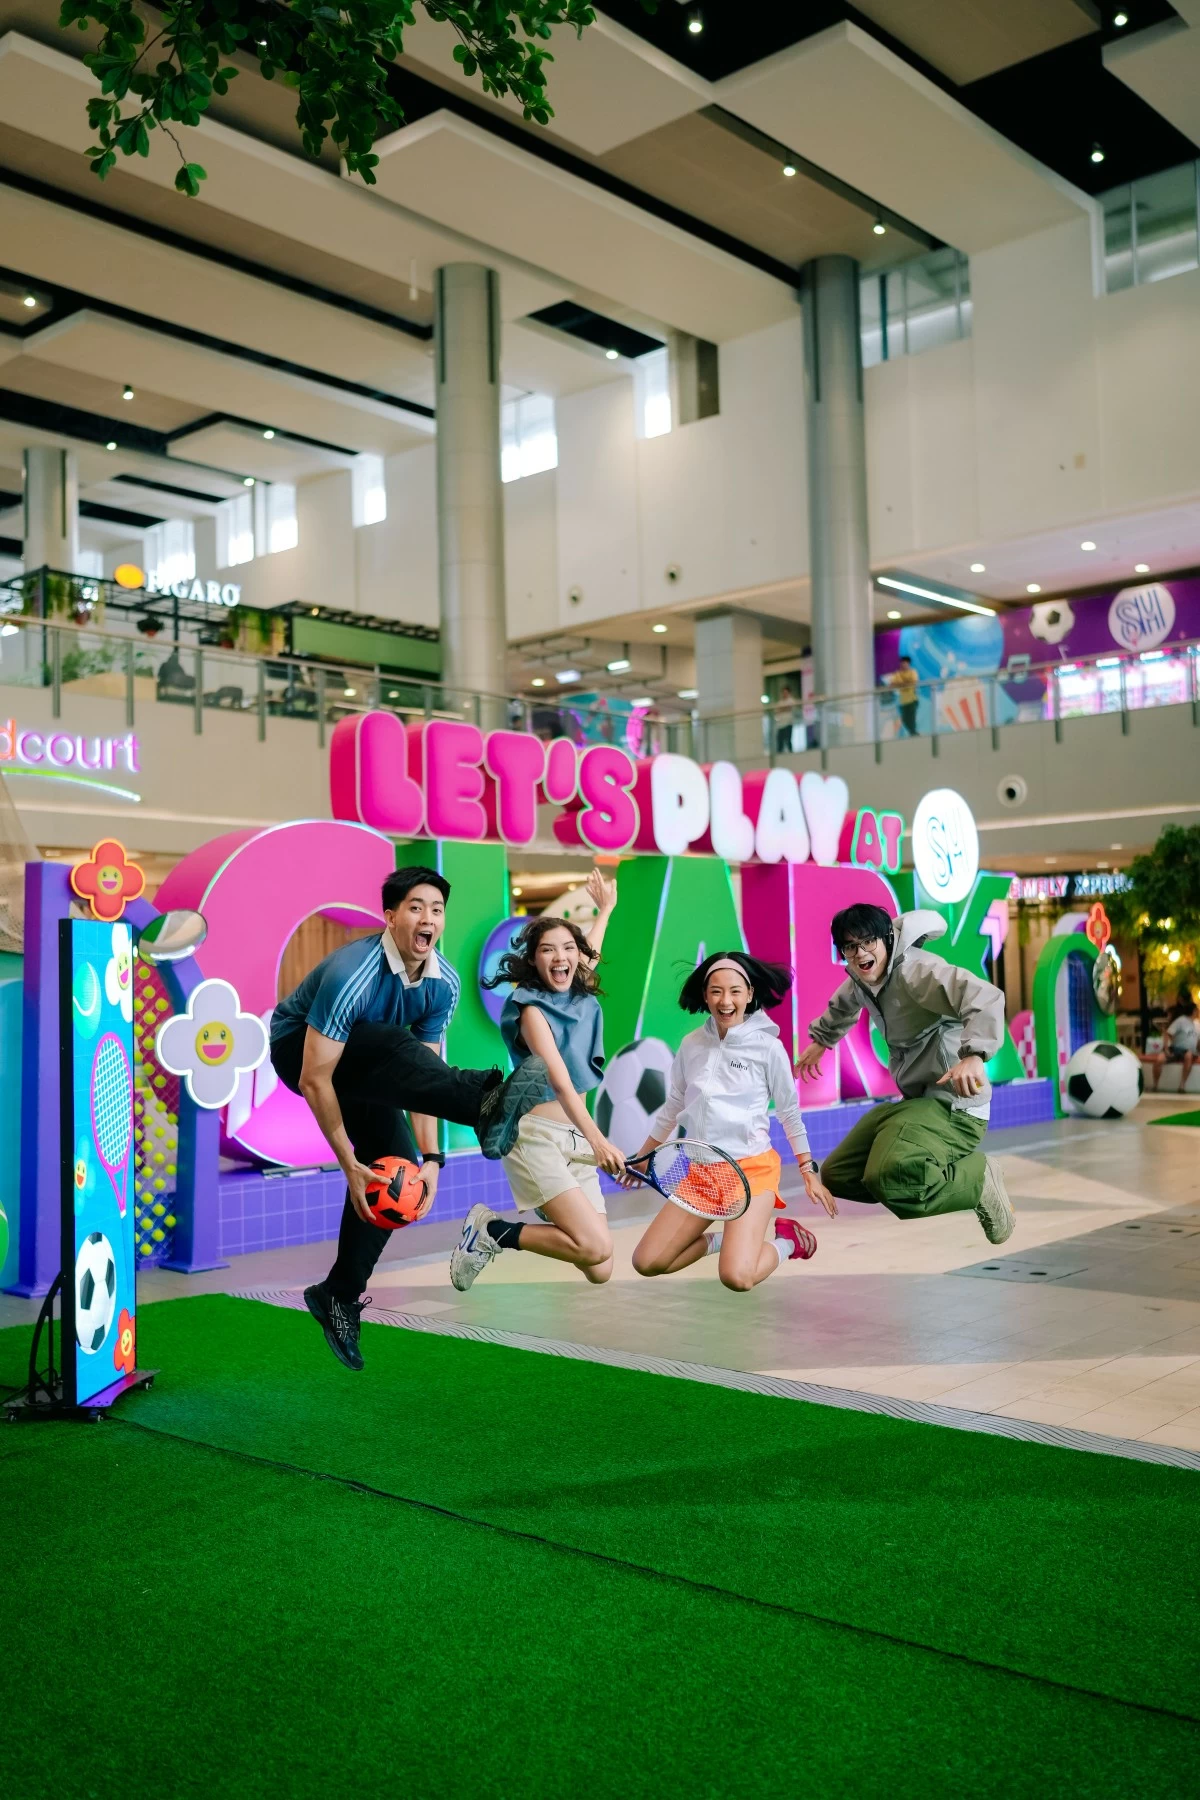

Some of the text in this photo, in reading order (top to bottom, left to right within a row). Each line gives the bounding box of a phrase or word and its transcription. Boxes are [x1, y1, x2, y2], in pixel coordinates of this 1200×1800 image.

[338, 711, 639, 854] LET'S
[650, 753, 849, 865] PLAY
[850, 806, 905, 875] AT
